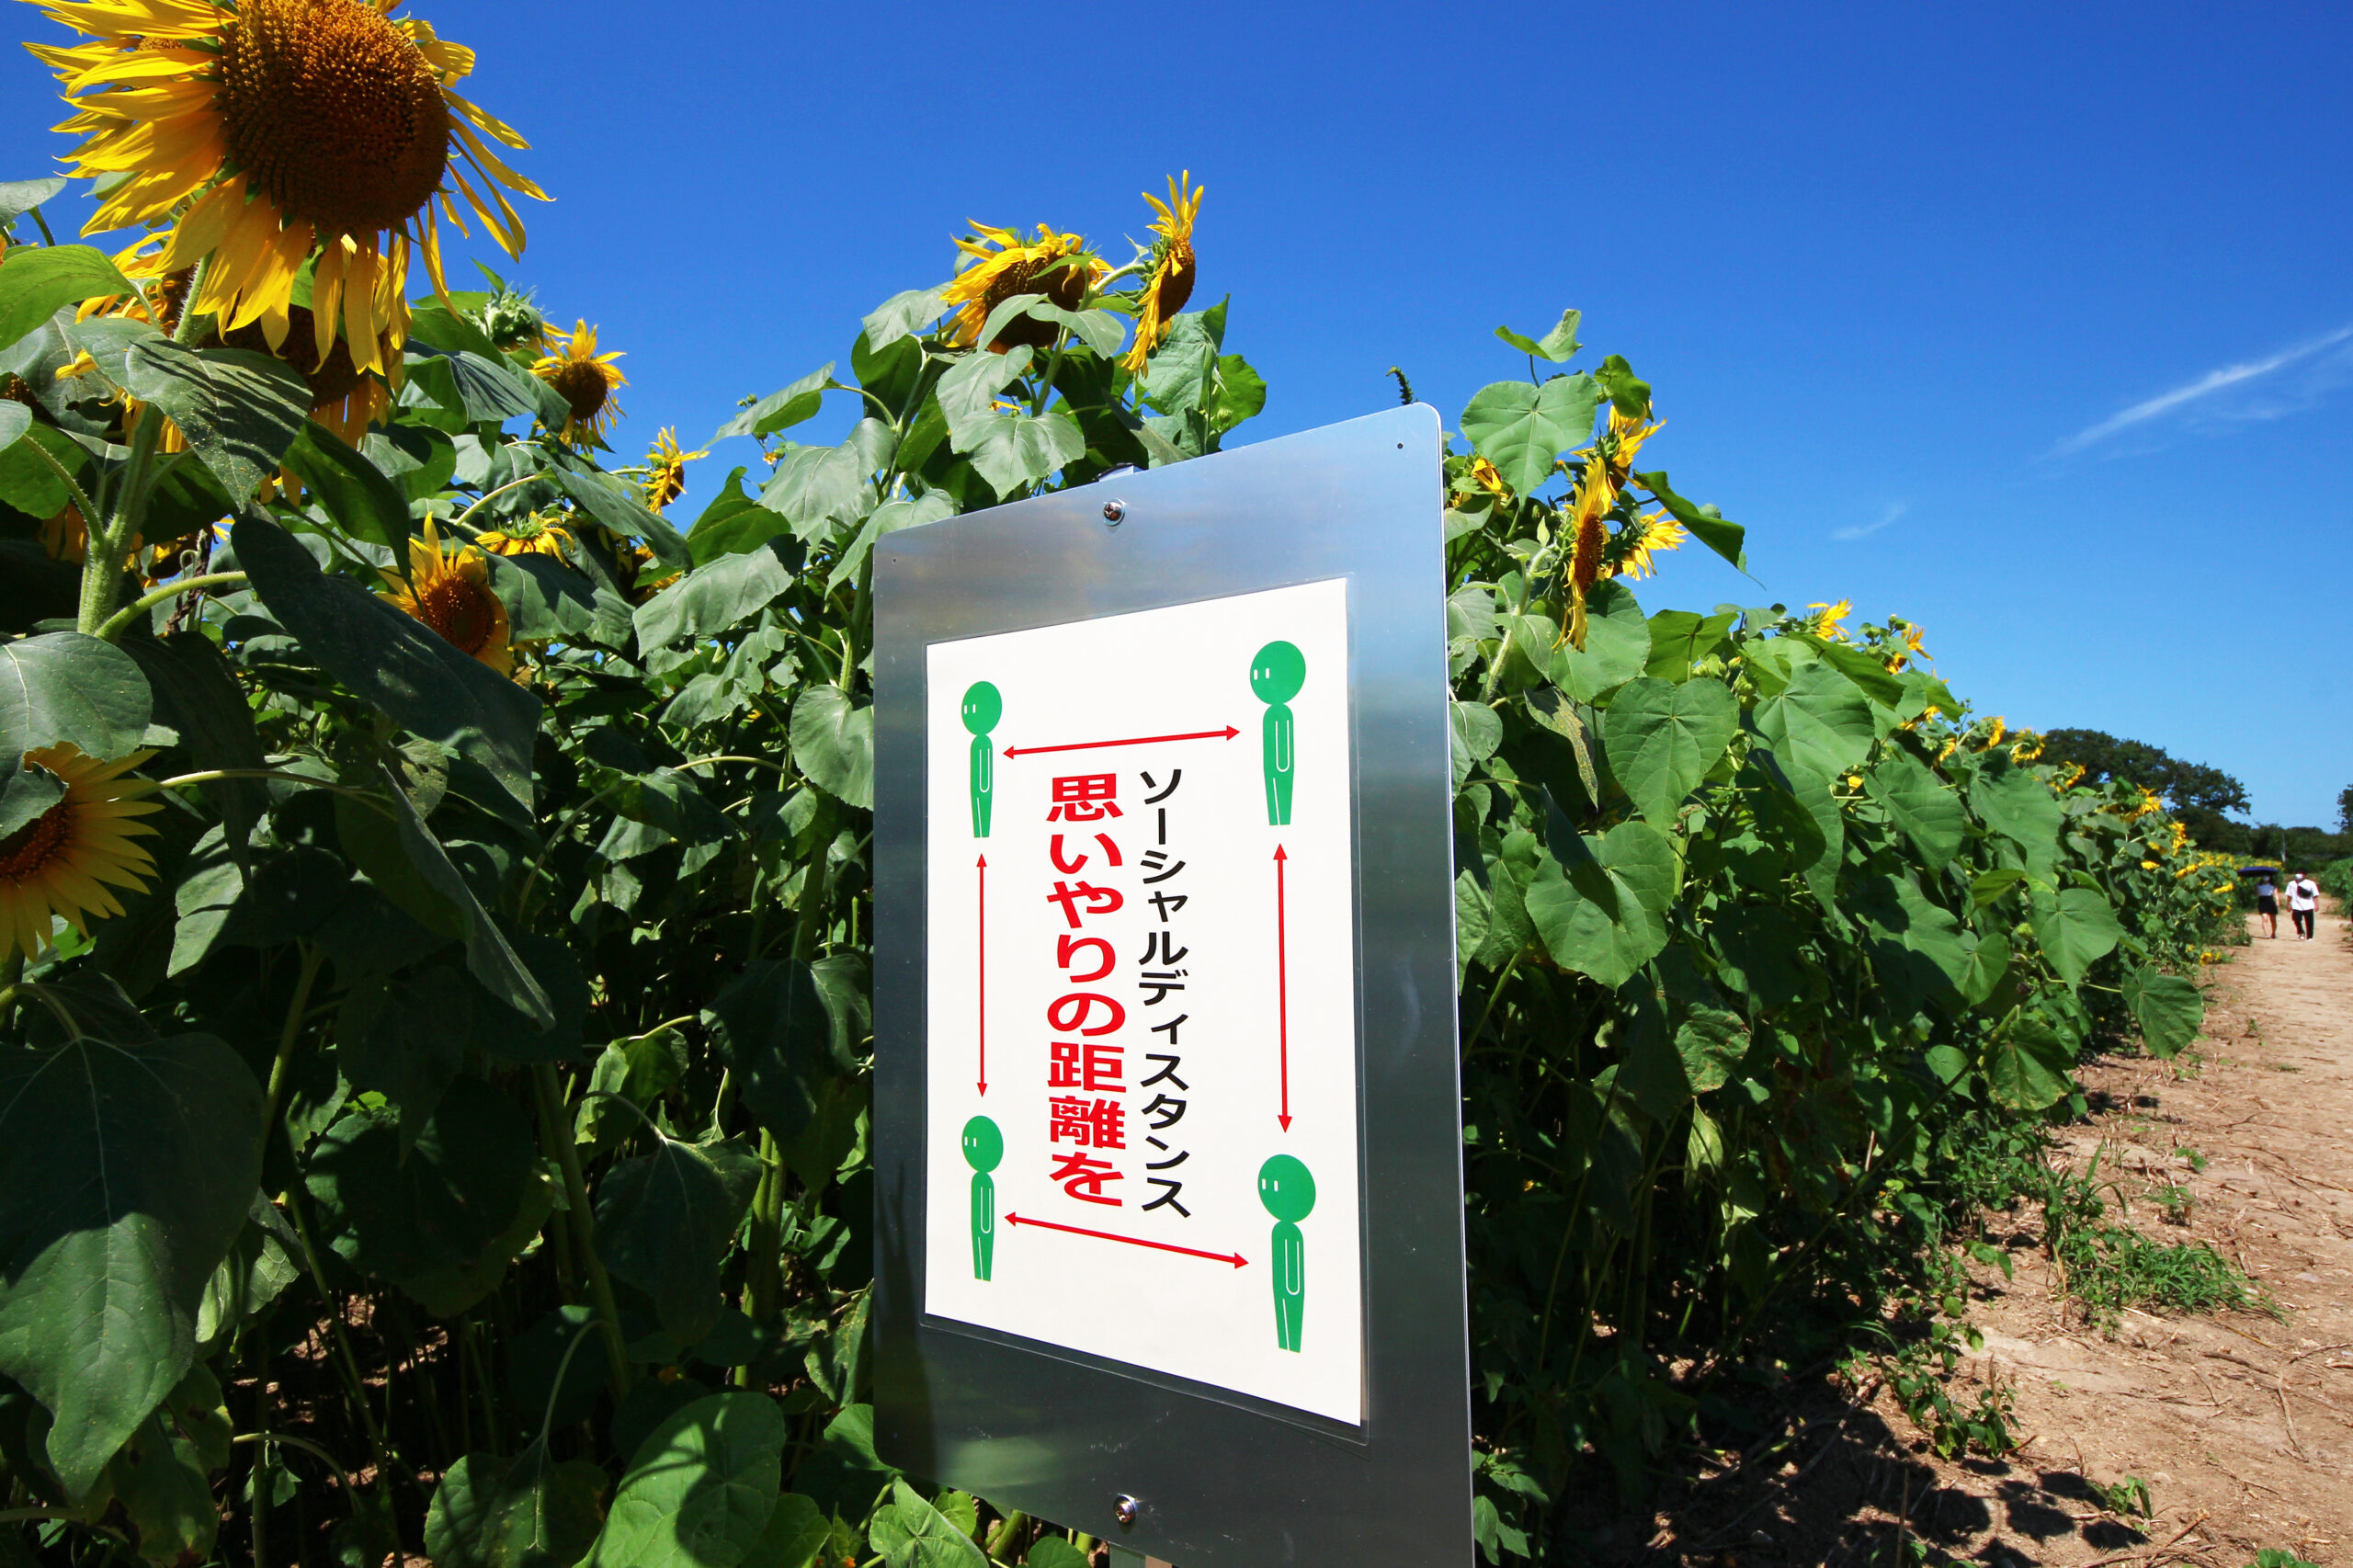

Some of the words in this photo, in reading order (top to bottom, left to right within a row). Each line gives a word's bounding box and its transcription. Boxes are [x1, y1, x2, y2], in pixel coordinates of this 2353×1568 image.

[1046, 772, 1127, 1207] 思いやりの距離を
[1138, 768, 1191, 1218] ソーシャルディスタンス
